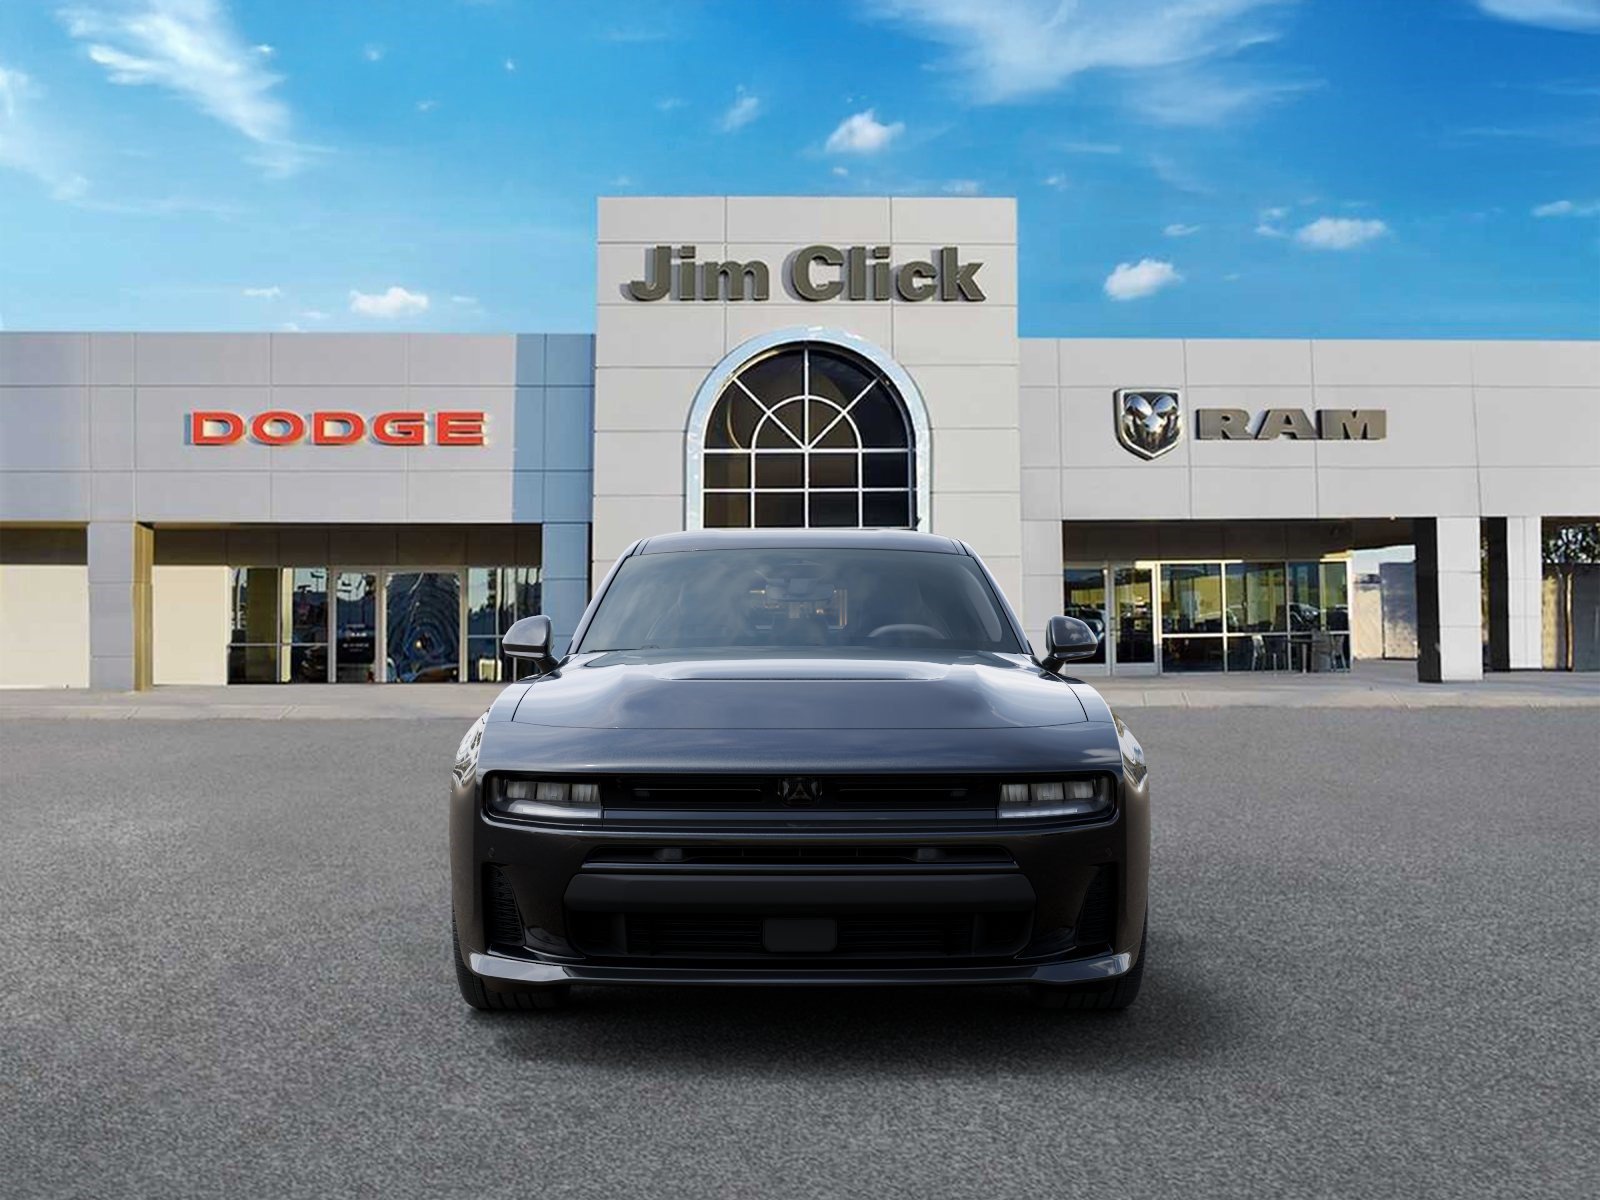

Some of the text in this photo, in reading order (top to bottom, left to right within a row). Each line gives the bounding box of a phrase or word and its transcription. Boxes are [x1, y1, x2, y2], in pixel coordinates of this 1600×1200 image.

[629, 245, 986, 301] Jim Click
[191, 411, 485, 446] DODGE
[1196, 408, 1387, 440] RAM
